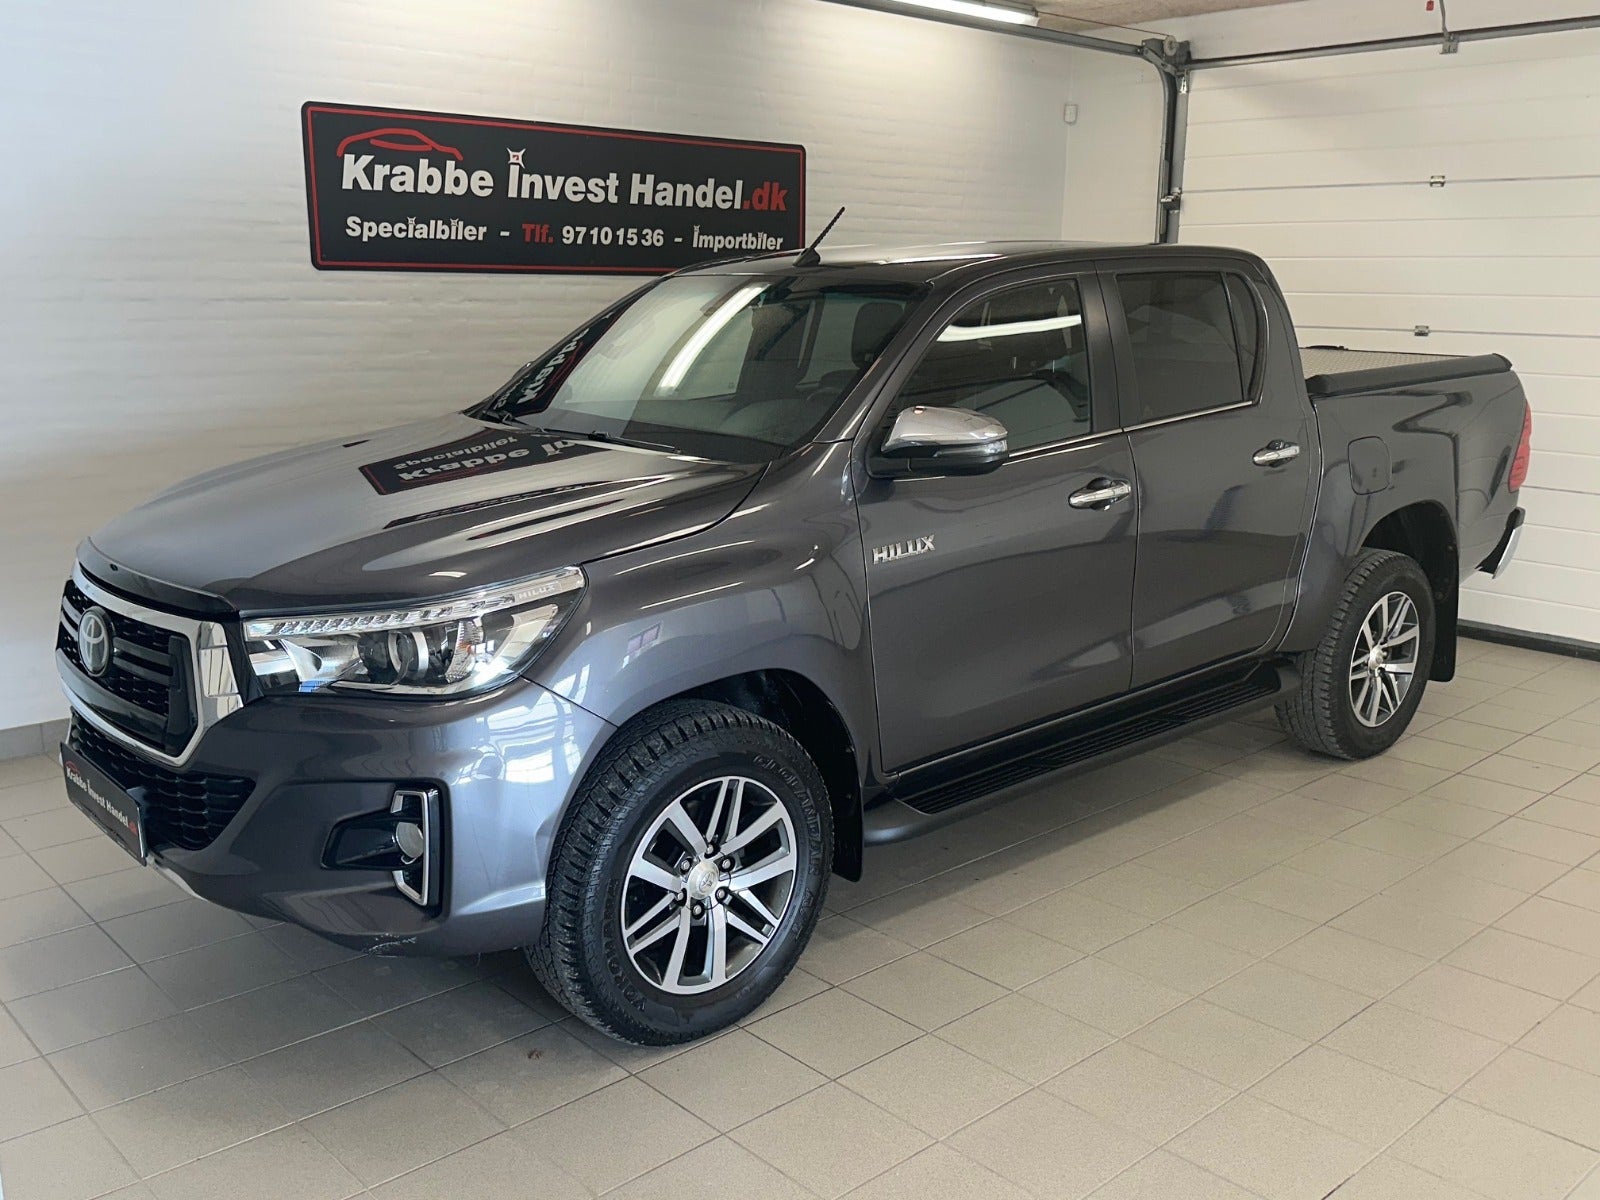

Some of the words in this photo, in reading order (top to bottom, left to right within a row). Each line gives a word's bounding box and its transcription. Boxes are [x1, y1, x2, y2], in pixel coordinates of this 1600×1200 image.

[342, 153, 494, 198] Krabbe
[630, 173, 788, 212] Handel.dk
[345, 215, 488, 242] Specialbiler
[521, 223, 554, 243] Tlf.
[872, 534, 936, 565] HILUX
